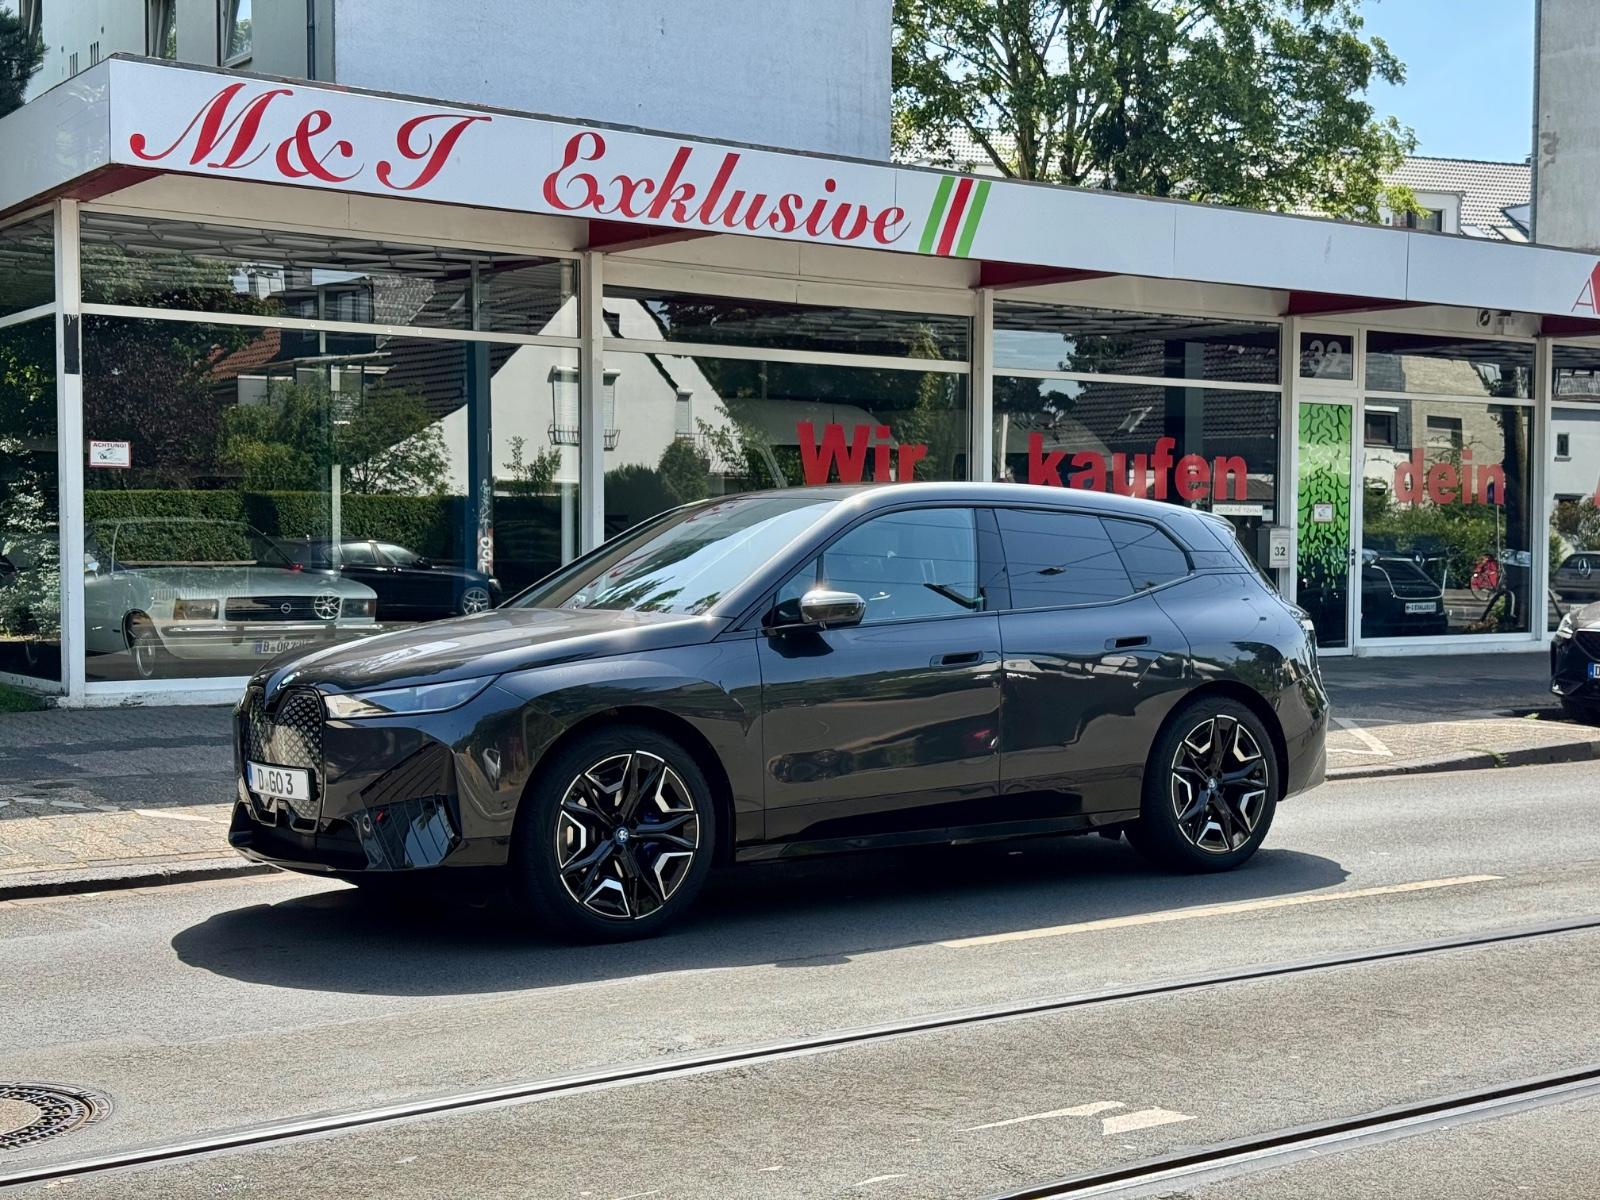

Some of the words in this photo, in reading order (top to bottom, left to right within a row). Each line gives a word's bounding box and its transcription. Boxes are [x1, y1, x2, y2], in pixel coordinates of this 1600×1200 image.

[129, 82, 294, 169] M
[275, 109, 364, 182] &
[542, 131, 912, 244] Exklusive
[1308, 339, 1343, 373] 32
[797, 421, 928, 485] Wir
[1028, 432, 1248, 500] kaufen
[1394, 447, 1505, 505] dein
[1274, 546, 1286, 556] 32
[257, 768, 264, 790] D
